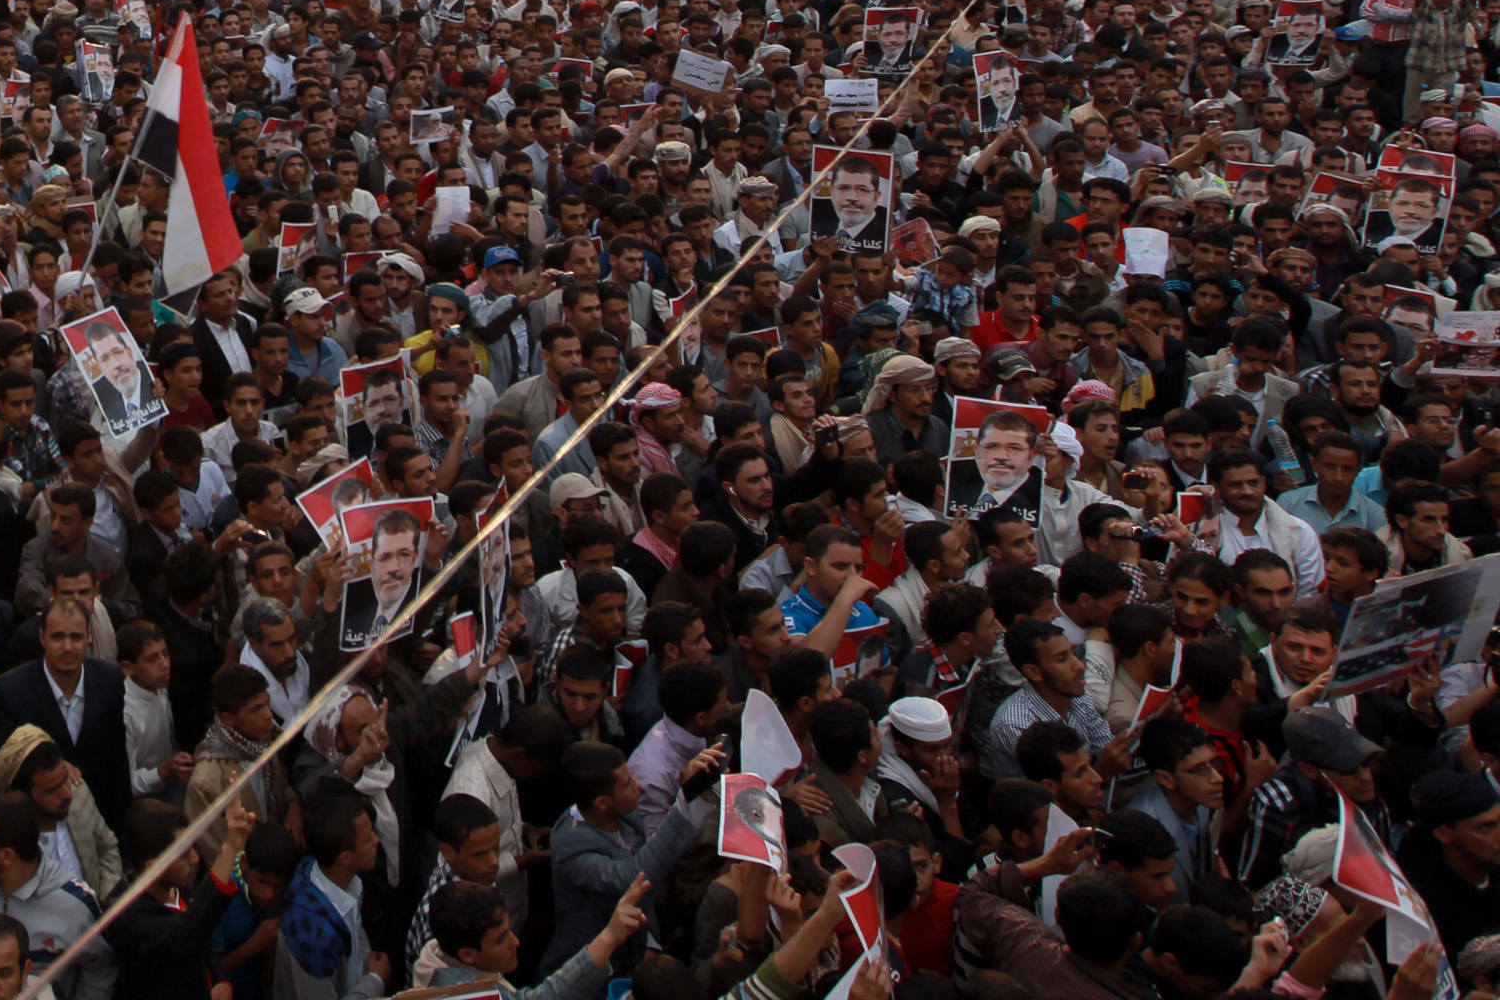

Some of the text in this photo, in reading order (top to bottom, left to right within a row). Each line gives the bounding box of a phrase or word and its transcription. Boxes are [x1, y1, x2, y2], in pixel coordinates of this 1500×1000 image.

[862, 239, 883, 251] كلنا
[145, 401, 162, 418] كلنا
[111, 411, 141, 432] الشرعية
[344, 625, 386, 647] الشرعية
